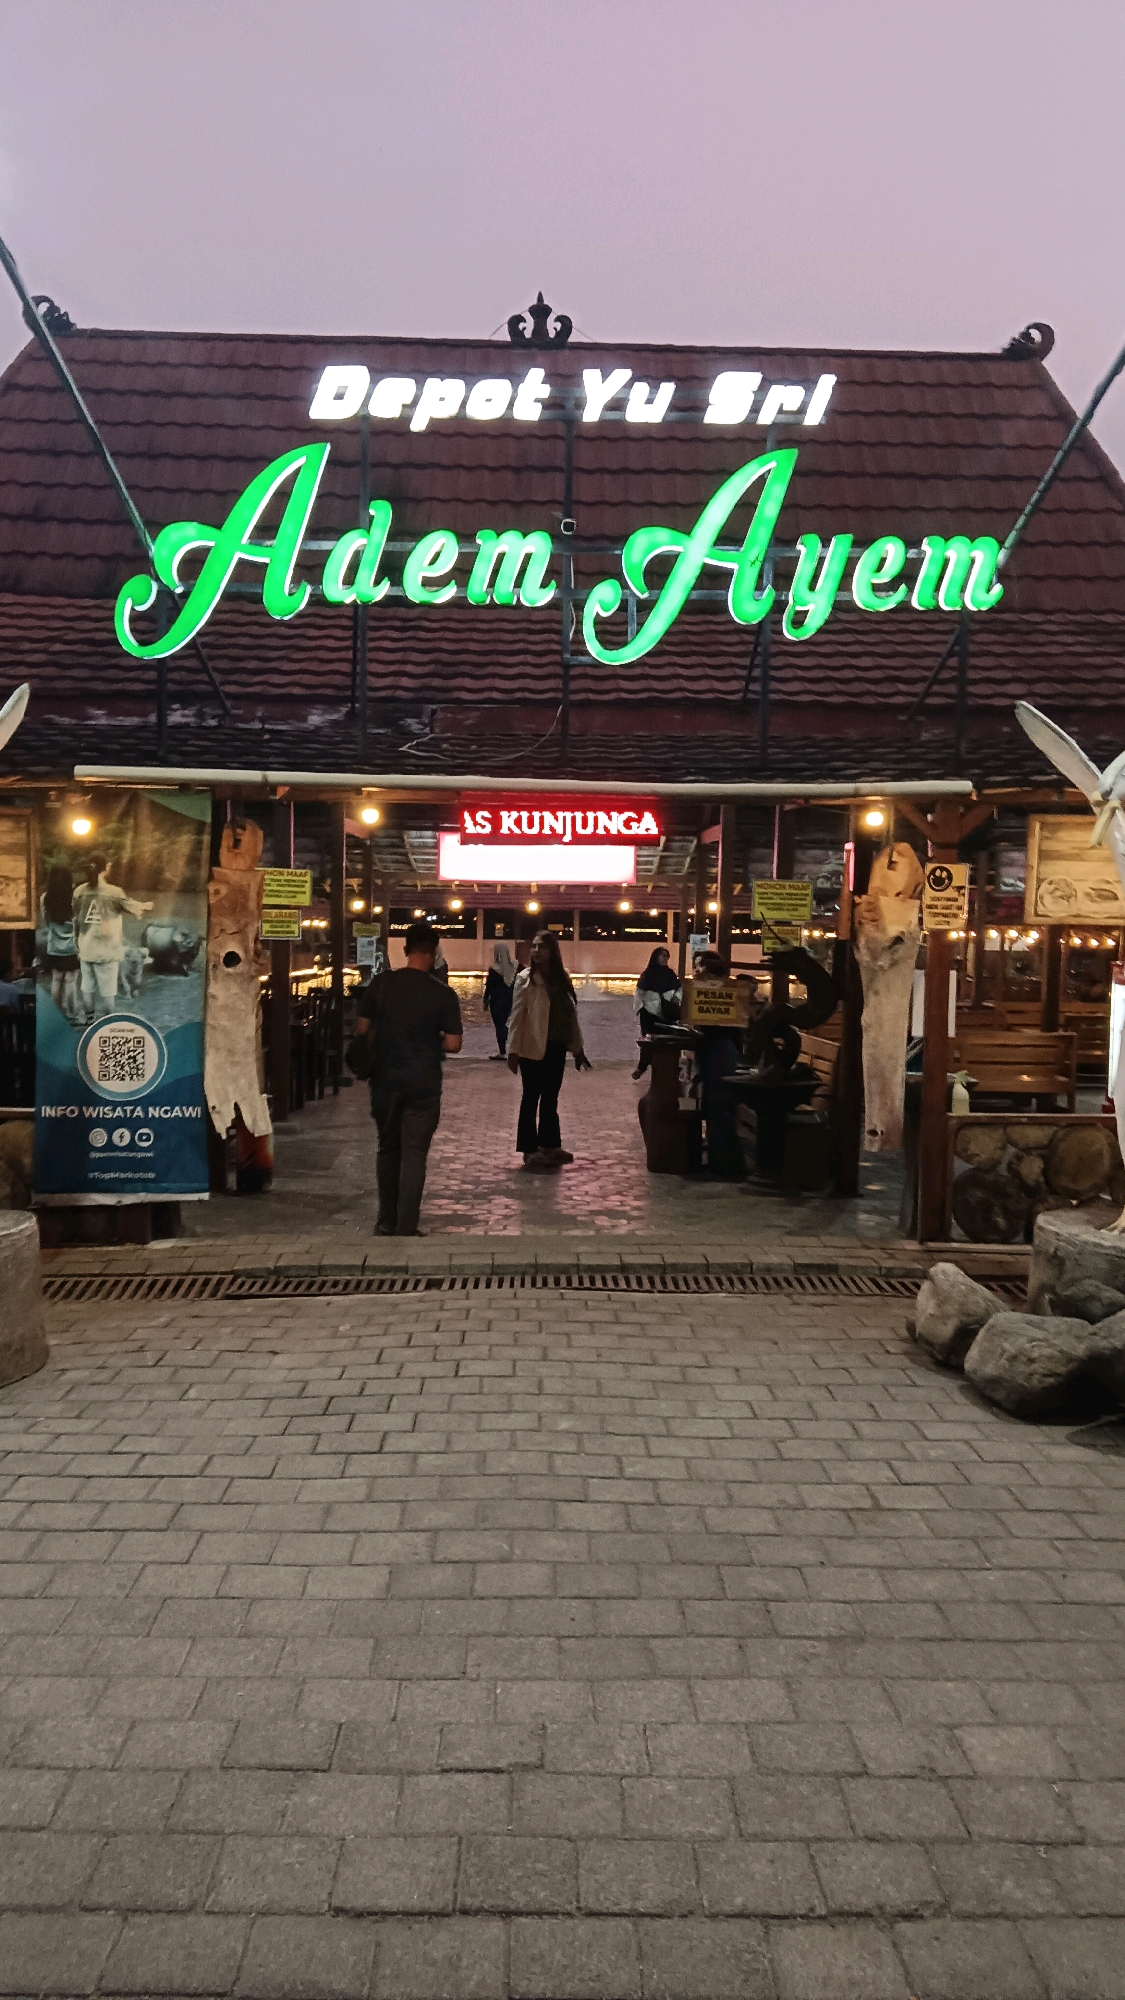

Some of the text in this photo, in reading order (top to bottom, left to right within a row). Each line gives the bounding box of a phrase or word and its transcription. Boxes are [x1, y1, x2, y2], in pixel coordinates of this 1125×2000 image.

[307, 364, 838, 432] Depot Yu Sri
[113, 442, 1007, 667] Adem Ayem
[500, 810, 659, 842] KUNJUNGA
[696, 990, 734, 1000] PESAN
[697, 1006, 731, 1015] BAYAR
[41, 1105, 202, 1119] INFO WISATA NGAWI
